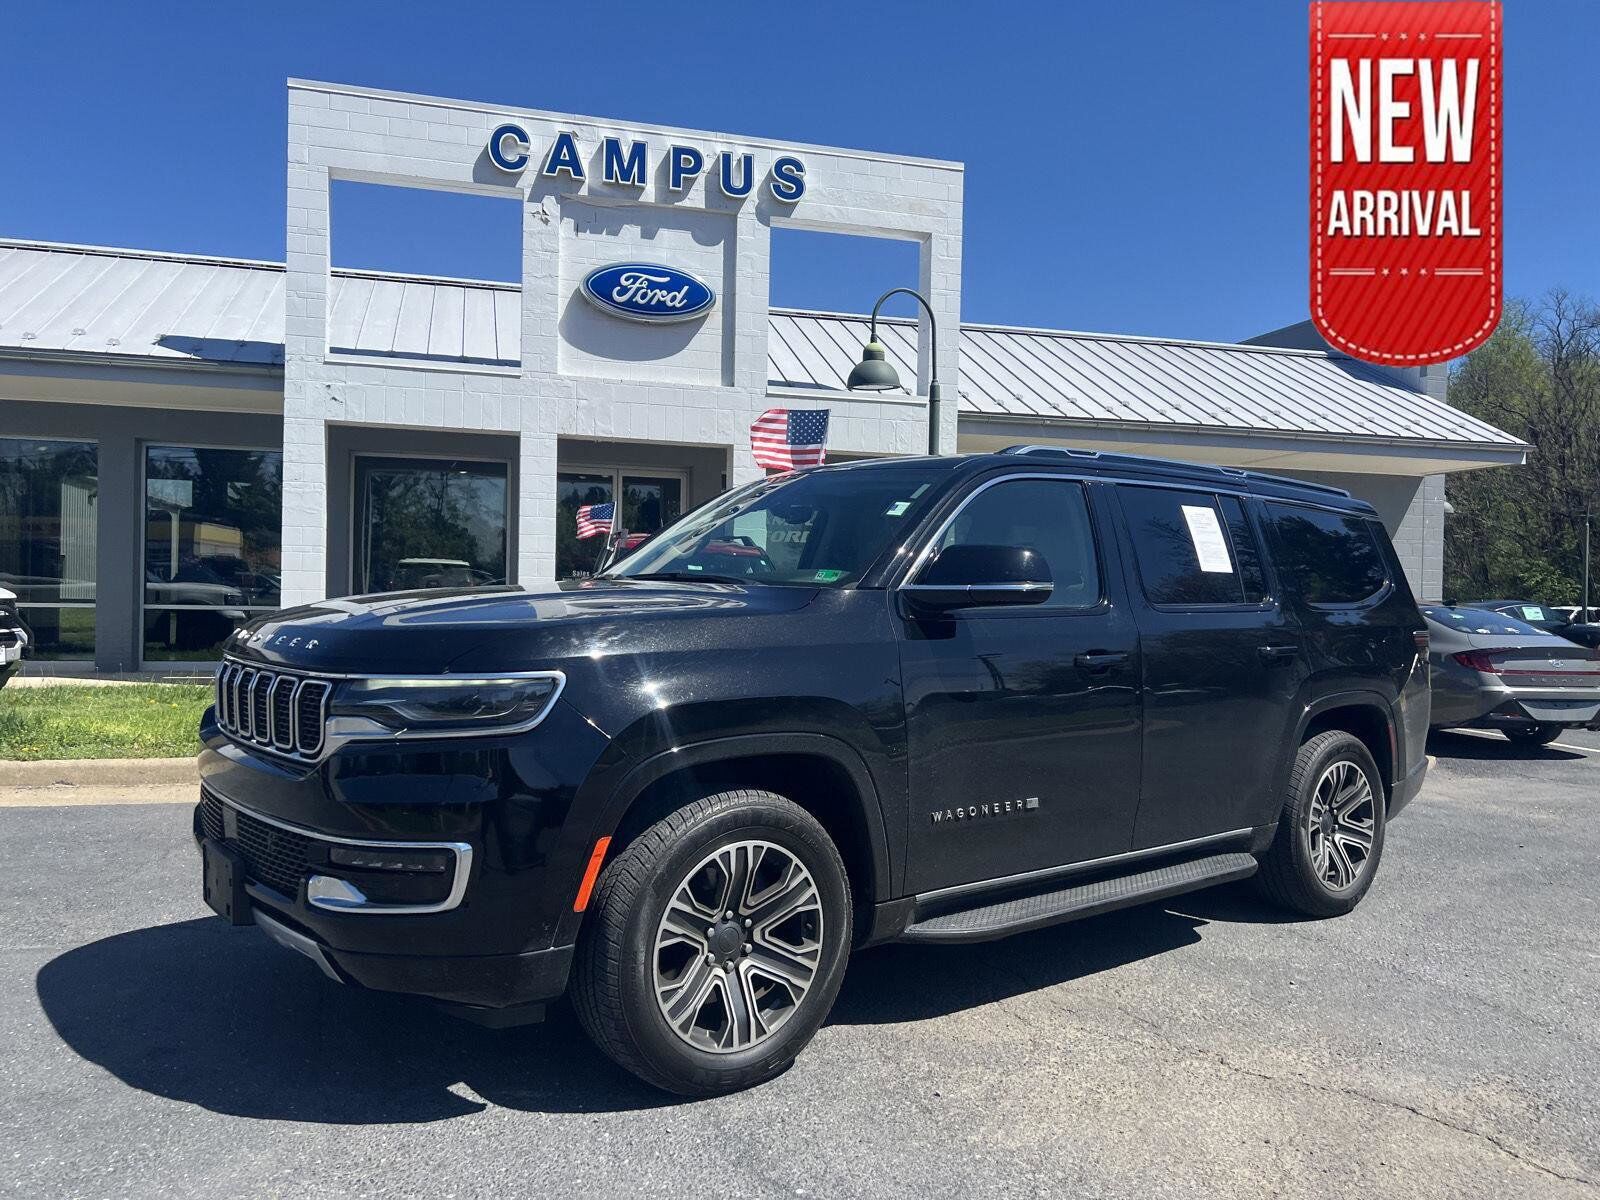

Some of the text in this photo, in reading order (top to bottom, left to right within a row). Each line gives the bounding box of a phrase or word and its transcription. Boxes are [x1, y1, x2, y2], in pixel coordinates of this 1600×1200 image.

[487, 123, 806, 203] CAMPUS
[612, 272, 689, 309] Ford
[572, 569, 590, 577] Sales
[931, 800, 1023, 822] WAGONEER
